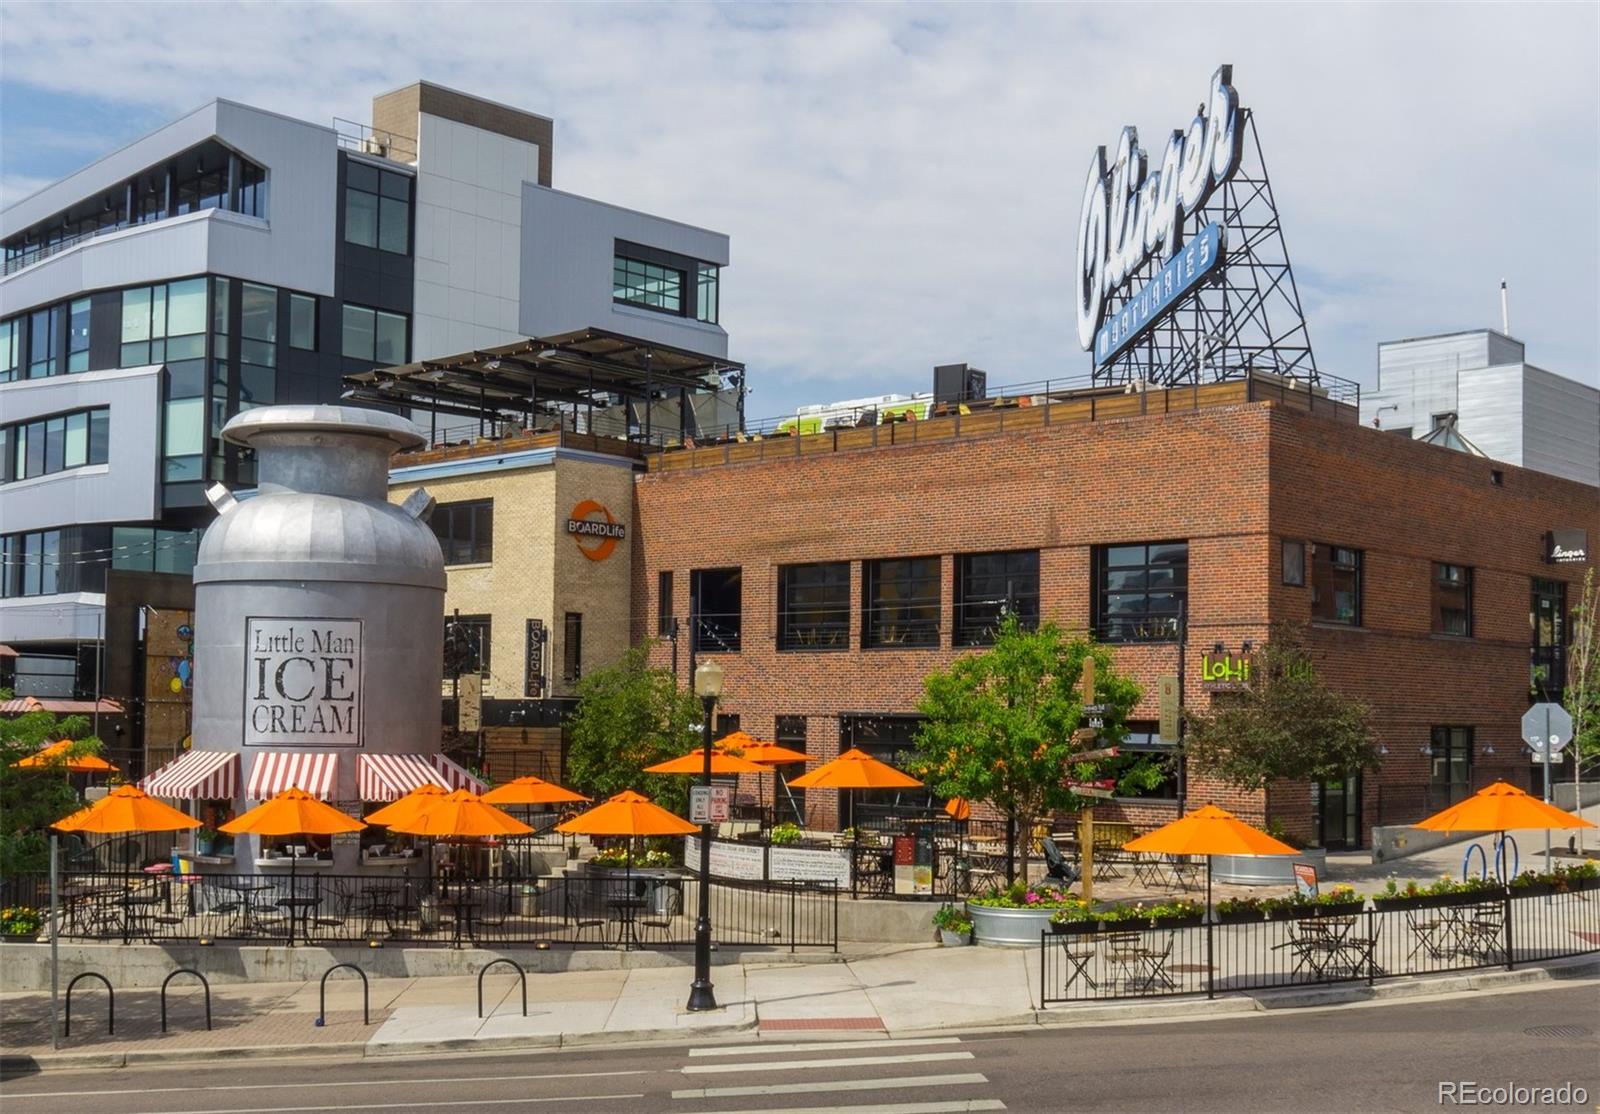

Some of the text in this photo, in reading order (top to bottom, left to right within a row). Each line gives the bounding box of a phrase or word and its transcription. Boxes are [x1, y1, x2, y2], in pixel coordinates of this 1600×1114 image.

[1099, 234, 1210, 356] MORTUARIES
[568, 520, 625, 538] BOARDLife
[254, 627, 355, 654] Little Man
[253, 656, 355, 702] ICE
[1202, 655, 1249, 682] LoHi
[252, 704, 355, 734] CREAM
